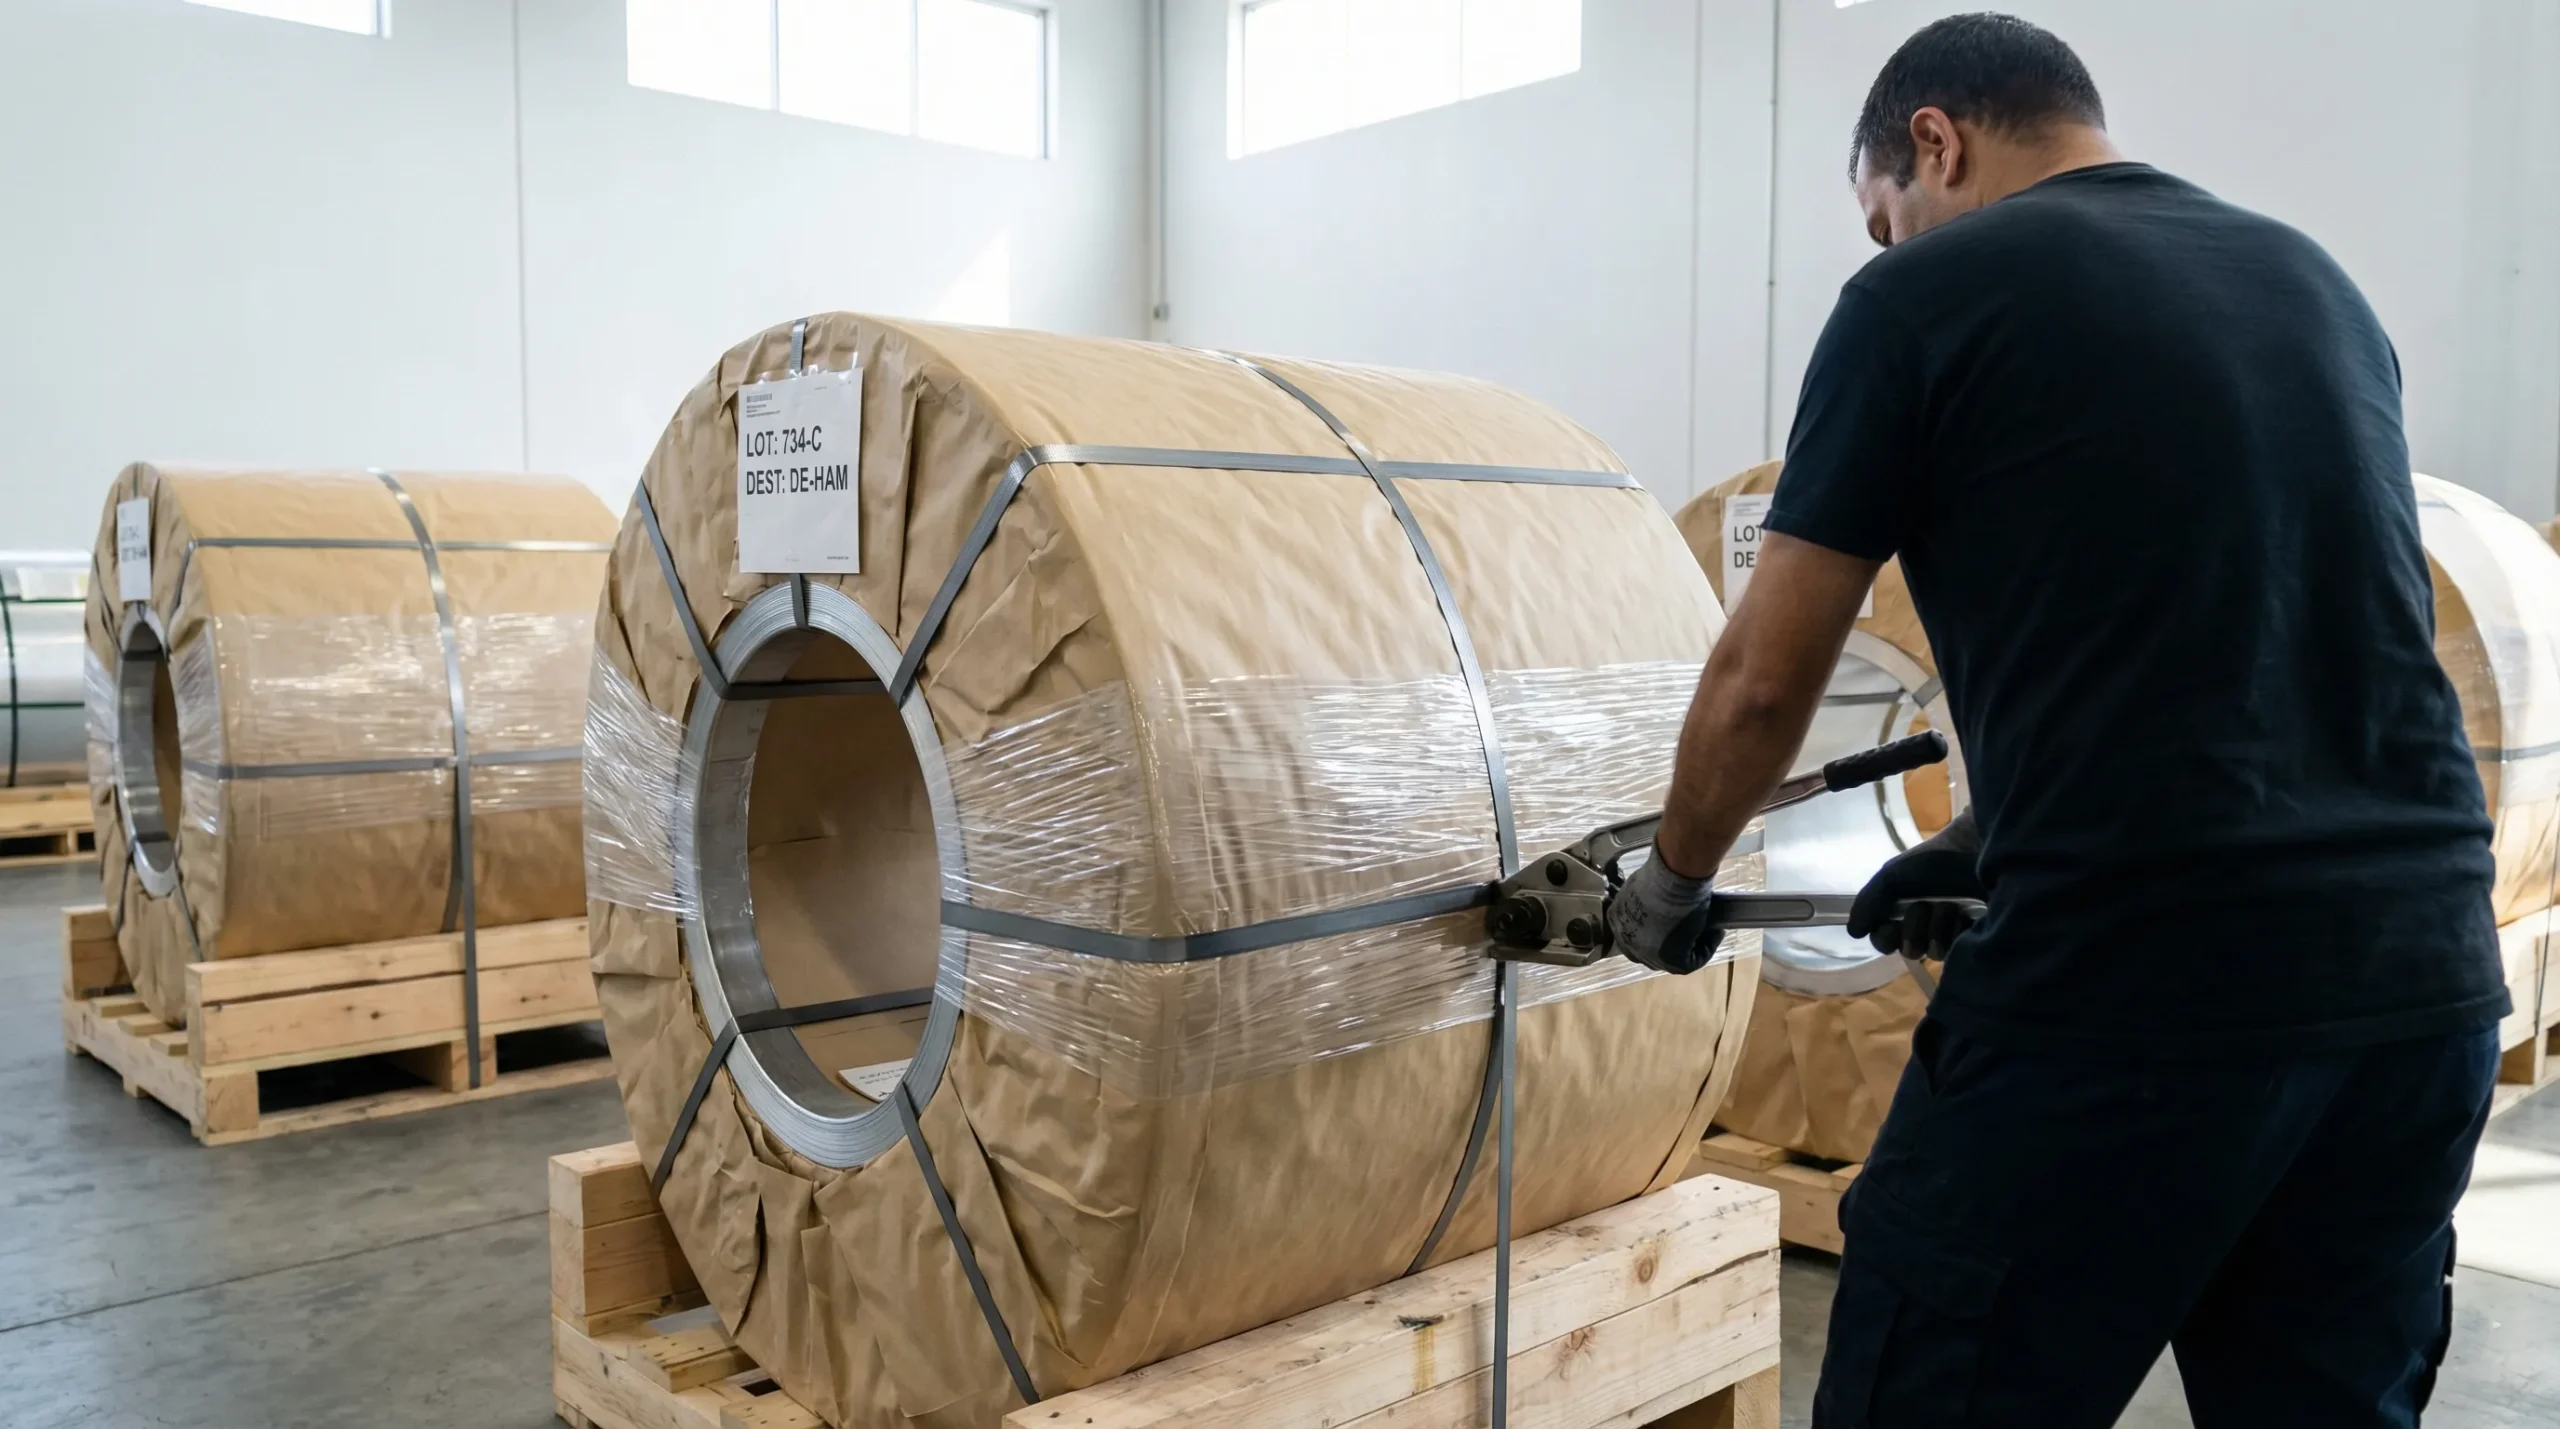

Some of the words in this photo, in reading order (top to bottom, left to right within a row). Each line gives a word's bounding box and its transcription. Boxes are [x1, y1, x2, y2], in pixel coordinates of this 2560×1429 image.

[746, 430, 778, 457] LOT:
[782, 425, 822, 455] 734-C
[746, 469, 785, 495] DEST:
[790, 464, 848, 493] DE-HAM
[1733, 551, 1760, 569] DE
